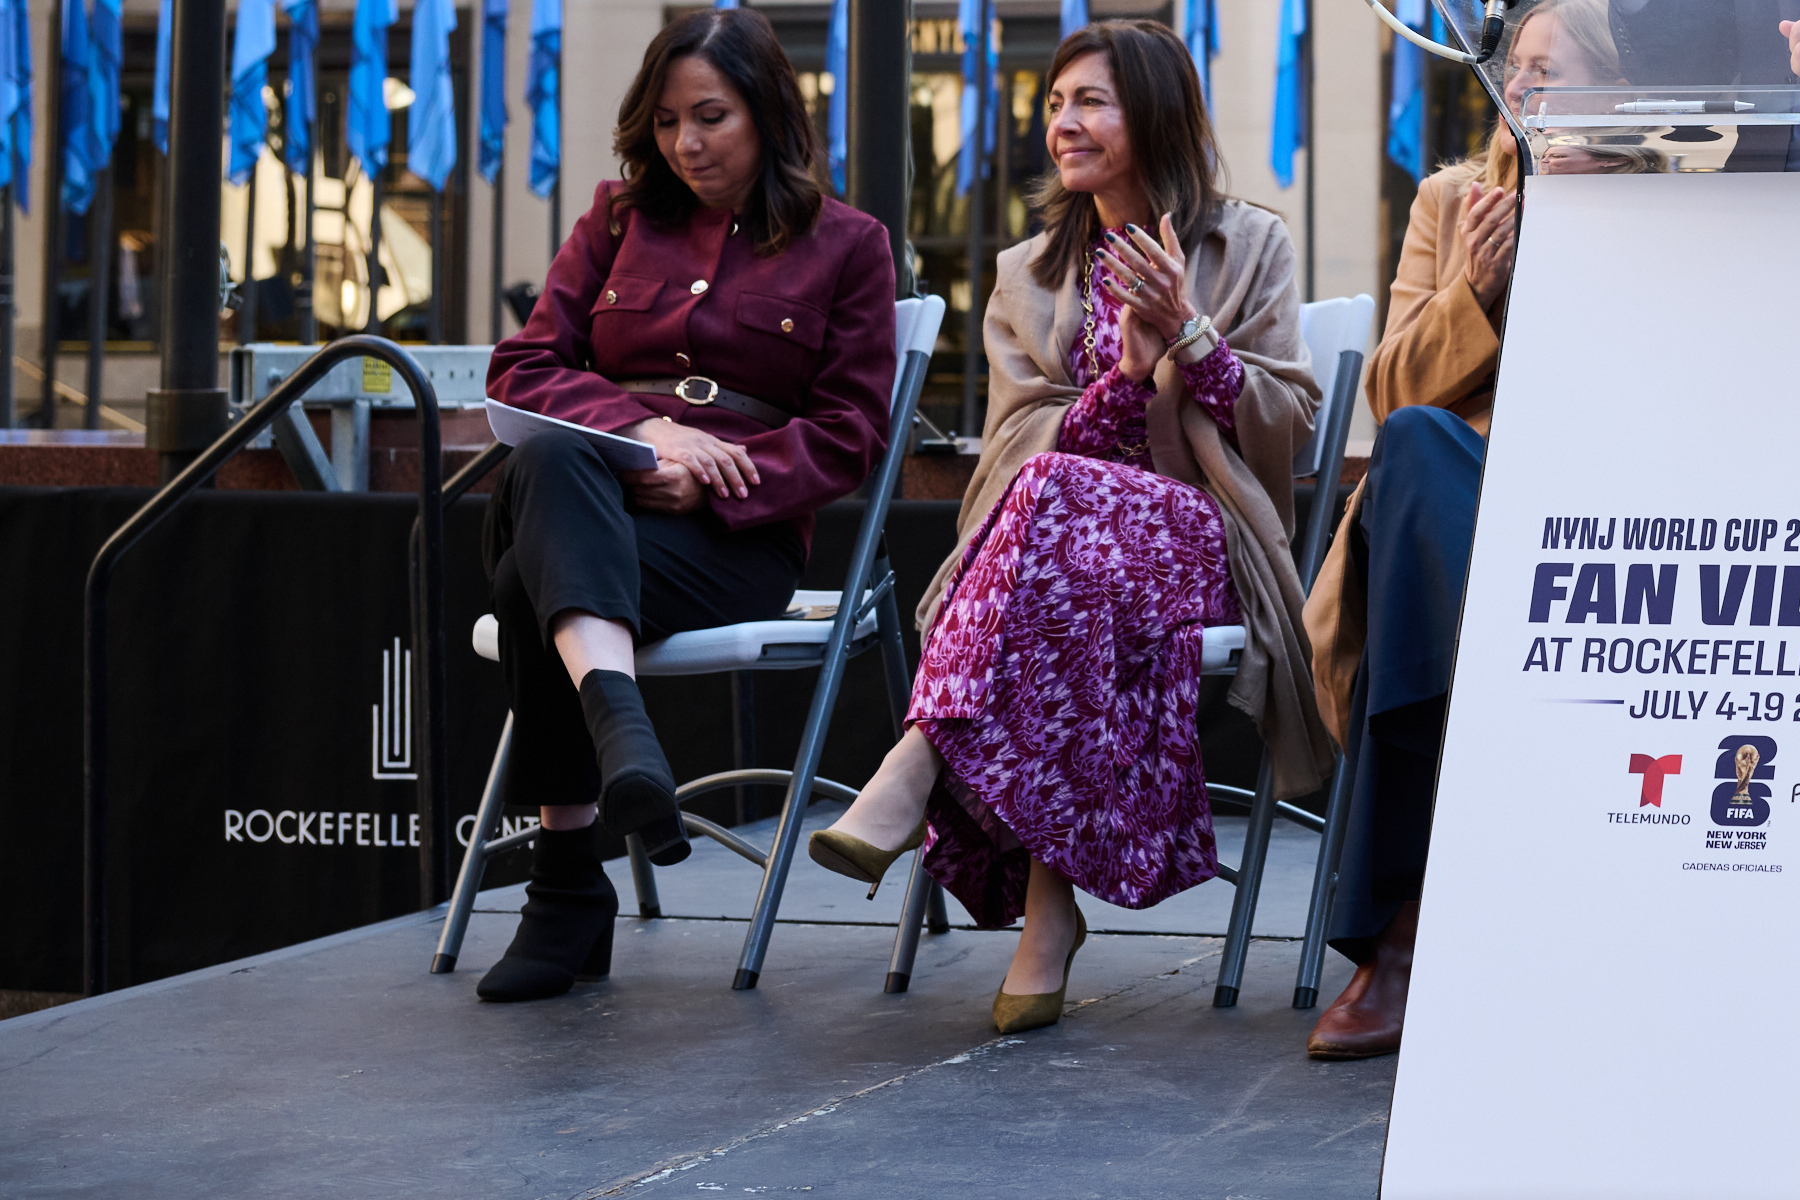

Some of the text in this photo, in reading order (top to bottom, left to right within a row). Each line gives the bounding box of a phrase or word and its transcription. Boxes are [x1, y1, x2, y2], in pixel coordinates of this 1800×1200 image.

[1542, 516, 1616, 551] NYNJ
[1623, 517, 1717, 551] WORLD
[1724, 517, 1778, 552] CUP
[1527, 562, 1678, 625] FAN
[1522, 636, 1573, 672] AT
[1629, 689, 1709, 720] JULY
[1715, 691, 1785, 722] 4-19
[1607, 812, 1691, 825] TELEMUNDO
[1726, 807, 1755, 819] FIFA
[224, 809, 421, 847] ROCKEFELLE
[1706, 830, 1767, 841] NEW YORK
[1705, 840, 1767, 850] NEW JERSEY
[1682, 862, 1783, 873] CADENAS OFICIALES
